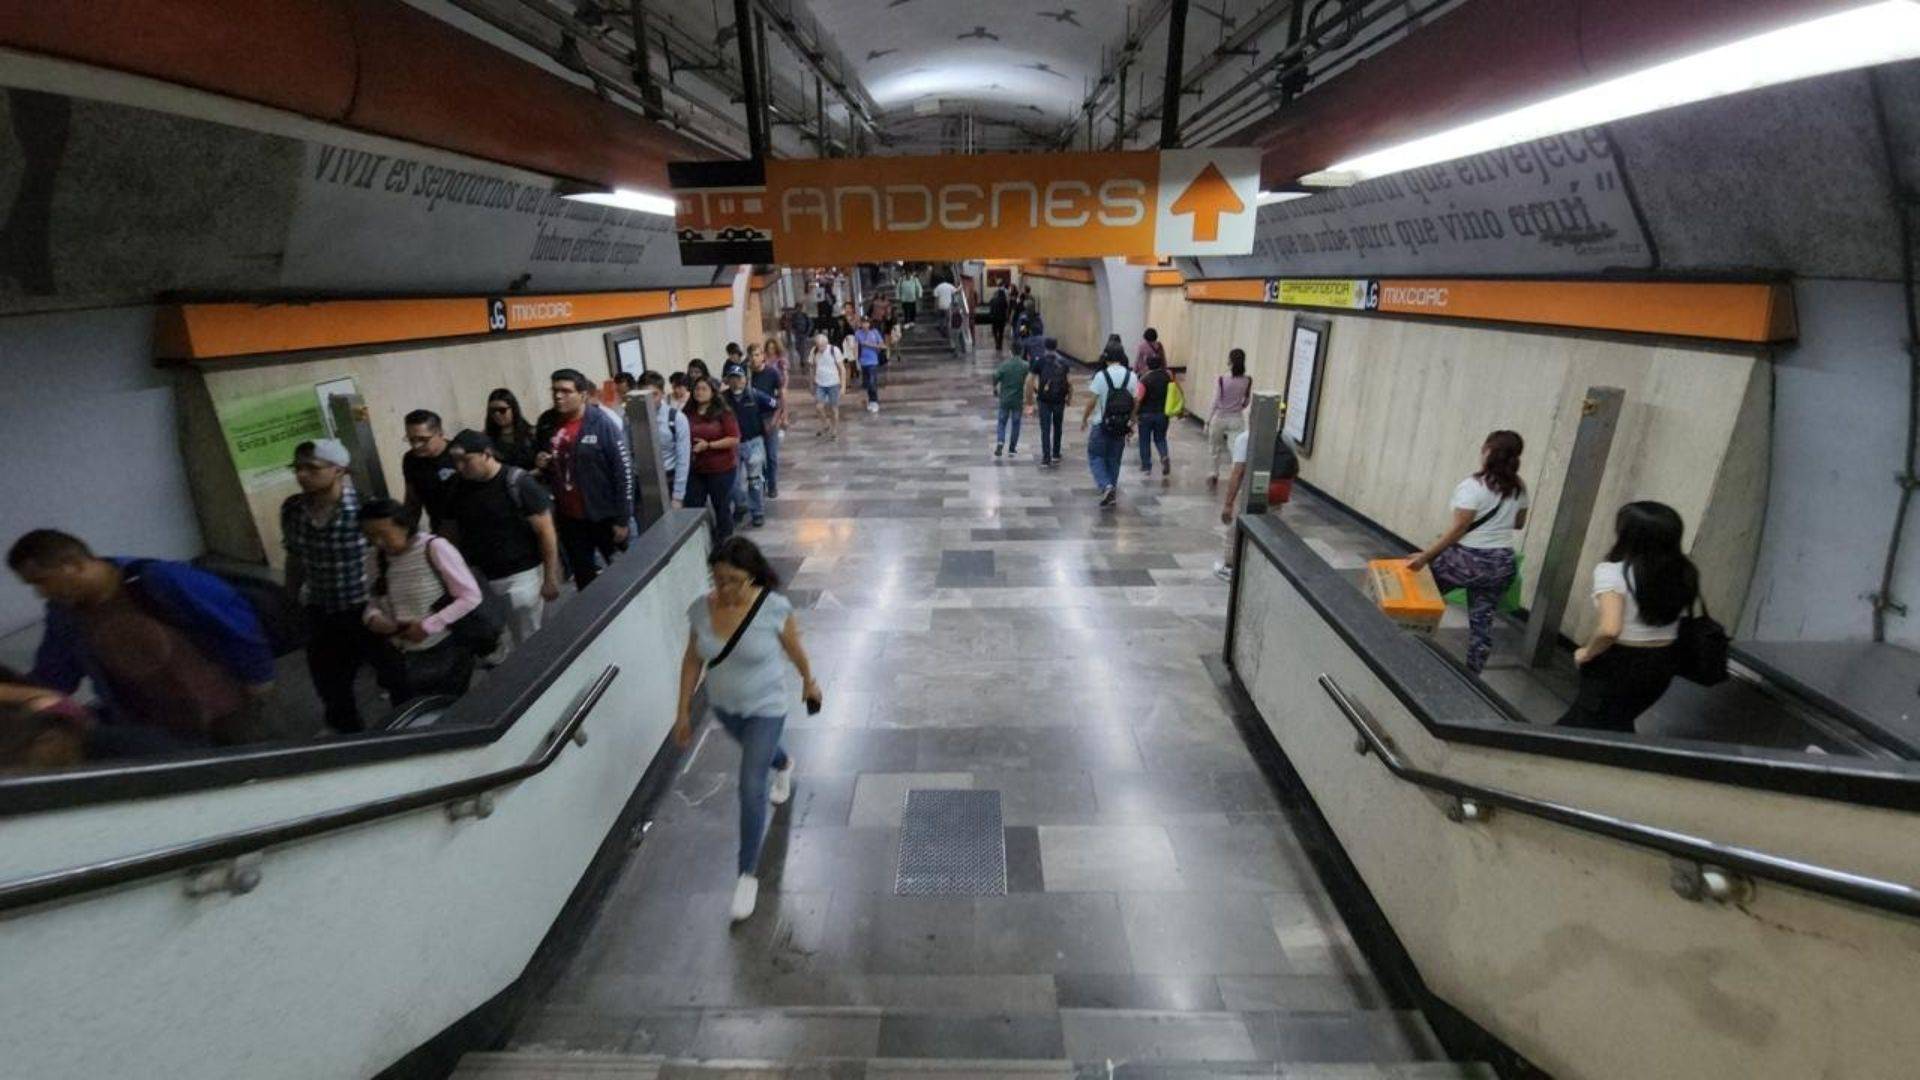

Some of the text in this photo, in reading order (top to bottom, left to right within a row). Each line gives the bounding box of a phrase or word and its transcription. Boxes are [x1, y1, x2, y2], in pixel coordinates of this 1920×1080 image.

[385, 158, 420, 193] es
[781, 179, 1146, 233] ANDENES
[1437, 202, 1504, 242] vino
[511, 301, 573, 322] MIXCOAC
[1383, 286, 1449, 307] MIXCOAC
